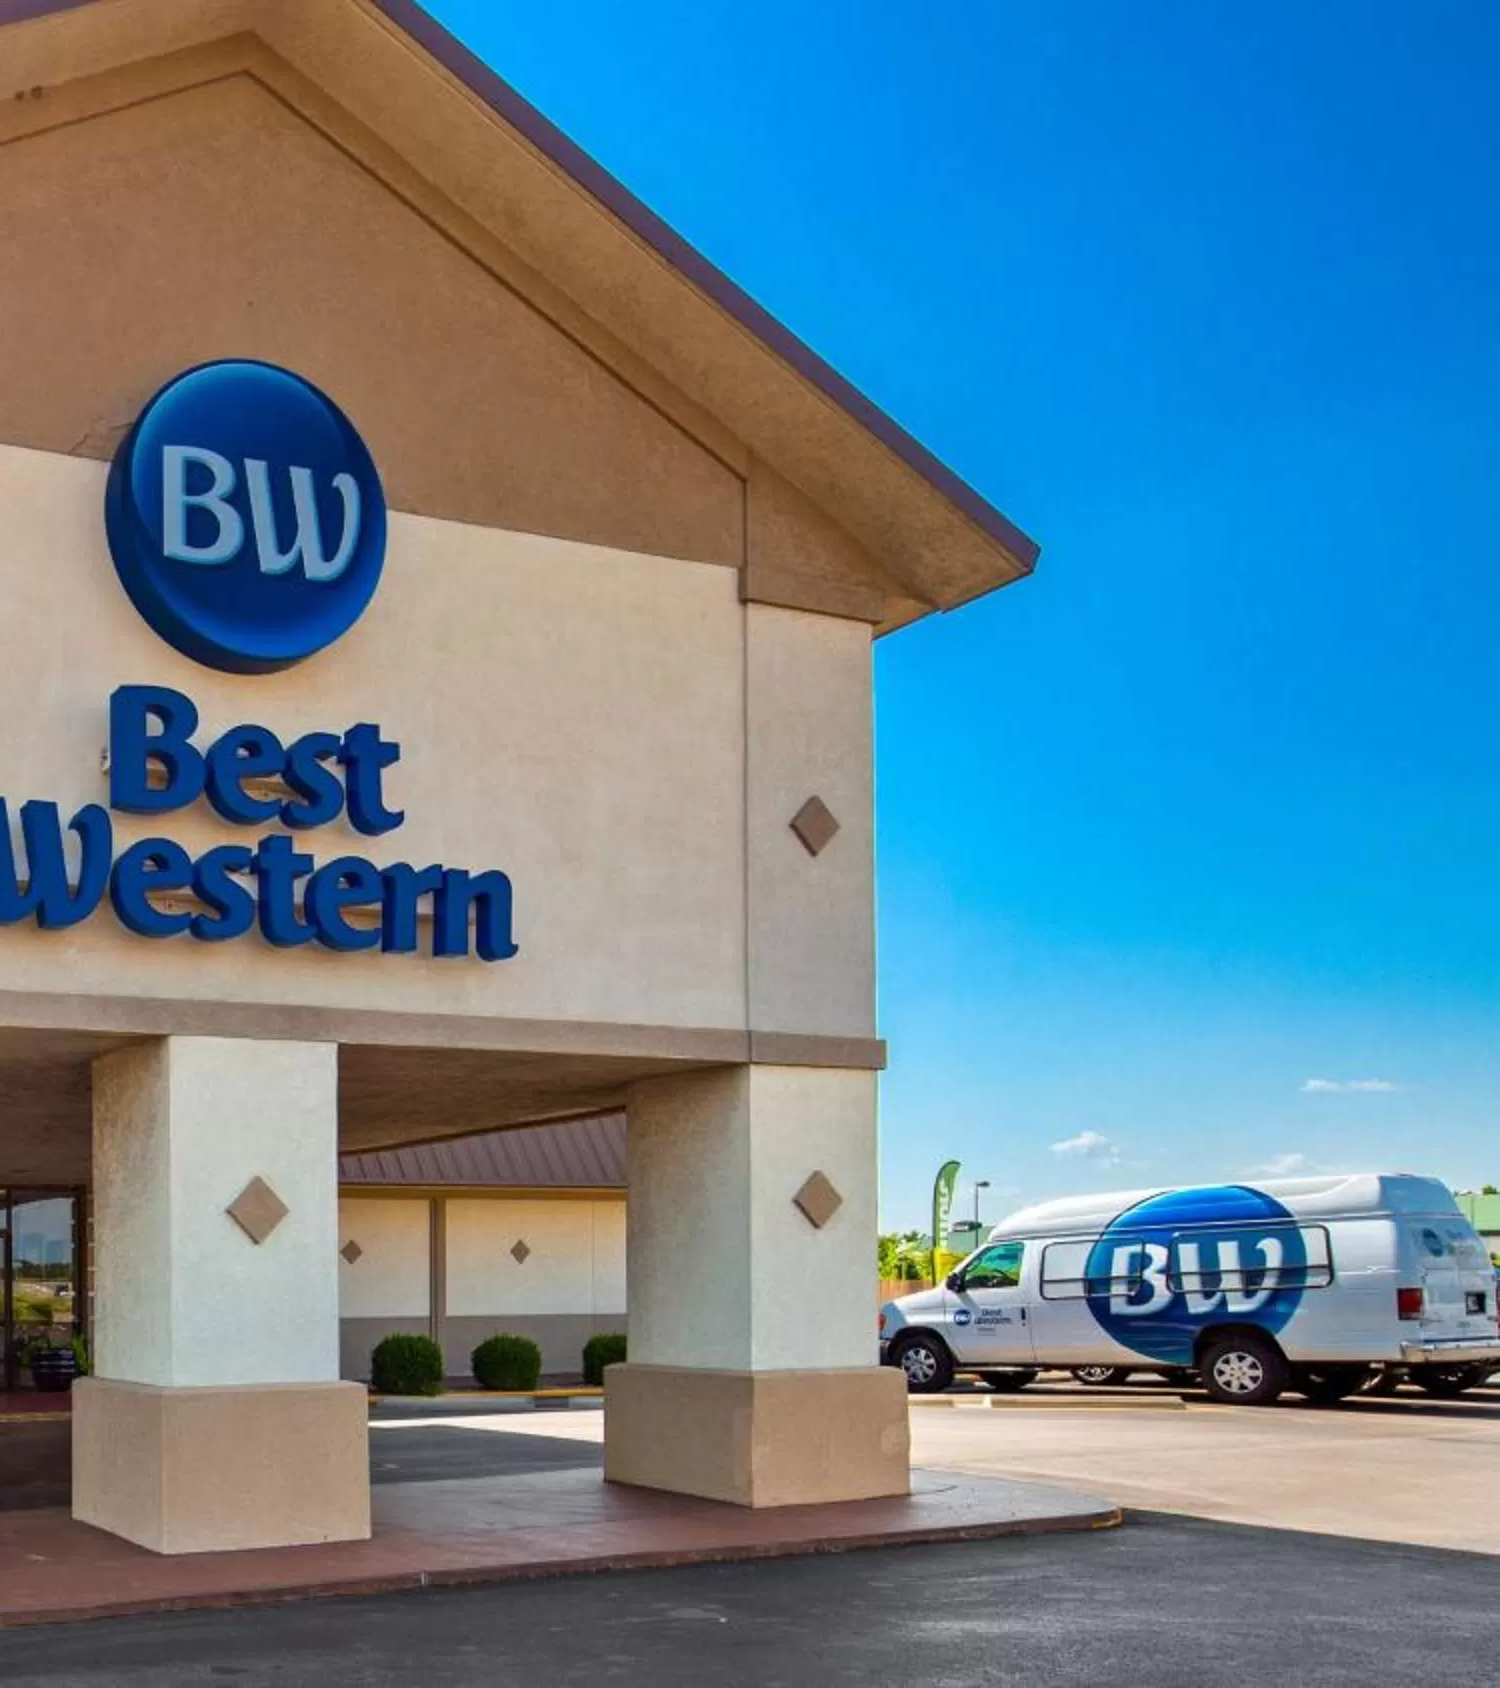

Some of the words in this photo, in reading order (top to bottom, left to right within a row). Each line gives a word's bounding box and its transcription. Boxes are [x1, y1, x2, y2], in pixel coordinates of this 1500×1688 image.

[162, 445, 361, 581] BW
[109, 684, 404, 836] Best
[1109, 1237, 1284, 1316] BW
